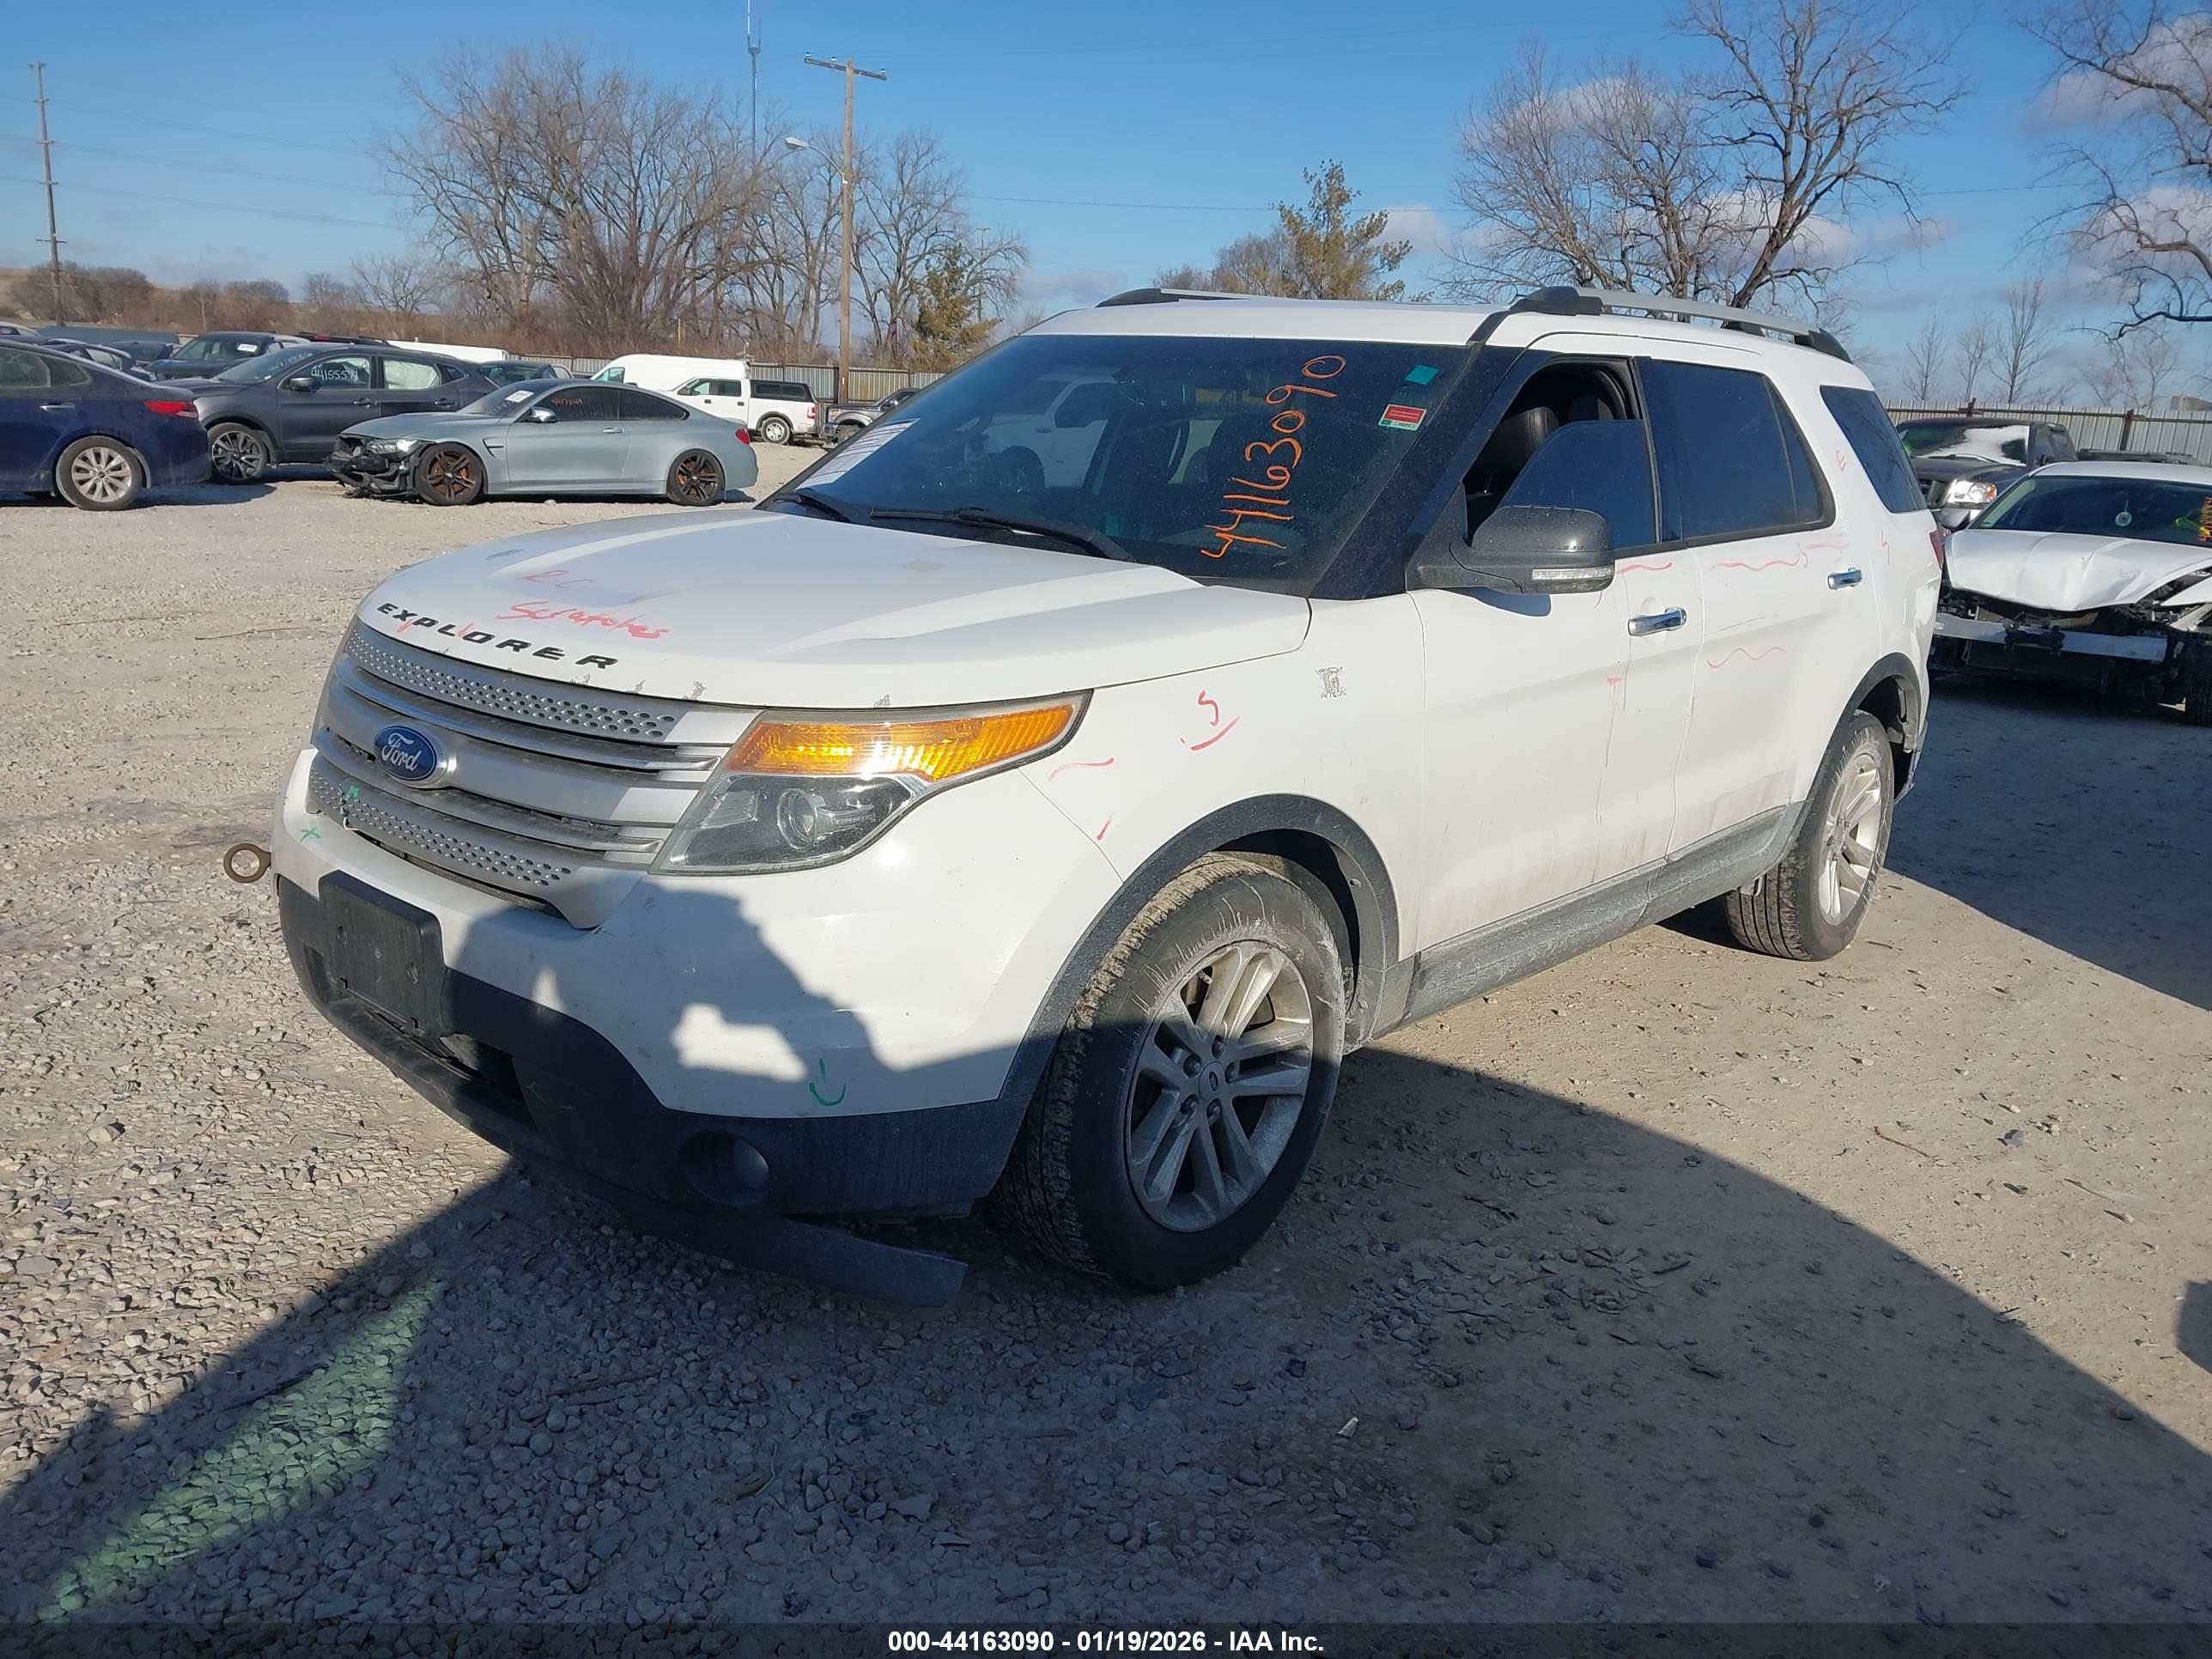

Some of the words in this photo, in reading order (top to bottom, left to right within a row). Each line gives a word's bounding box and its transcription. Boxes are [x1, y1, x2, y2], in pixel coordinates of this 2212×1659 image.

[1201, 355, 1346, 558] 44163090
[376, 602, 619, 670] EXPLORER
[381, 732, 422, 771] Ford
